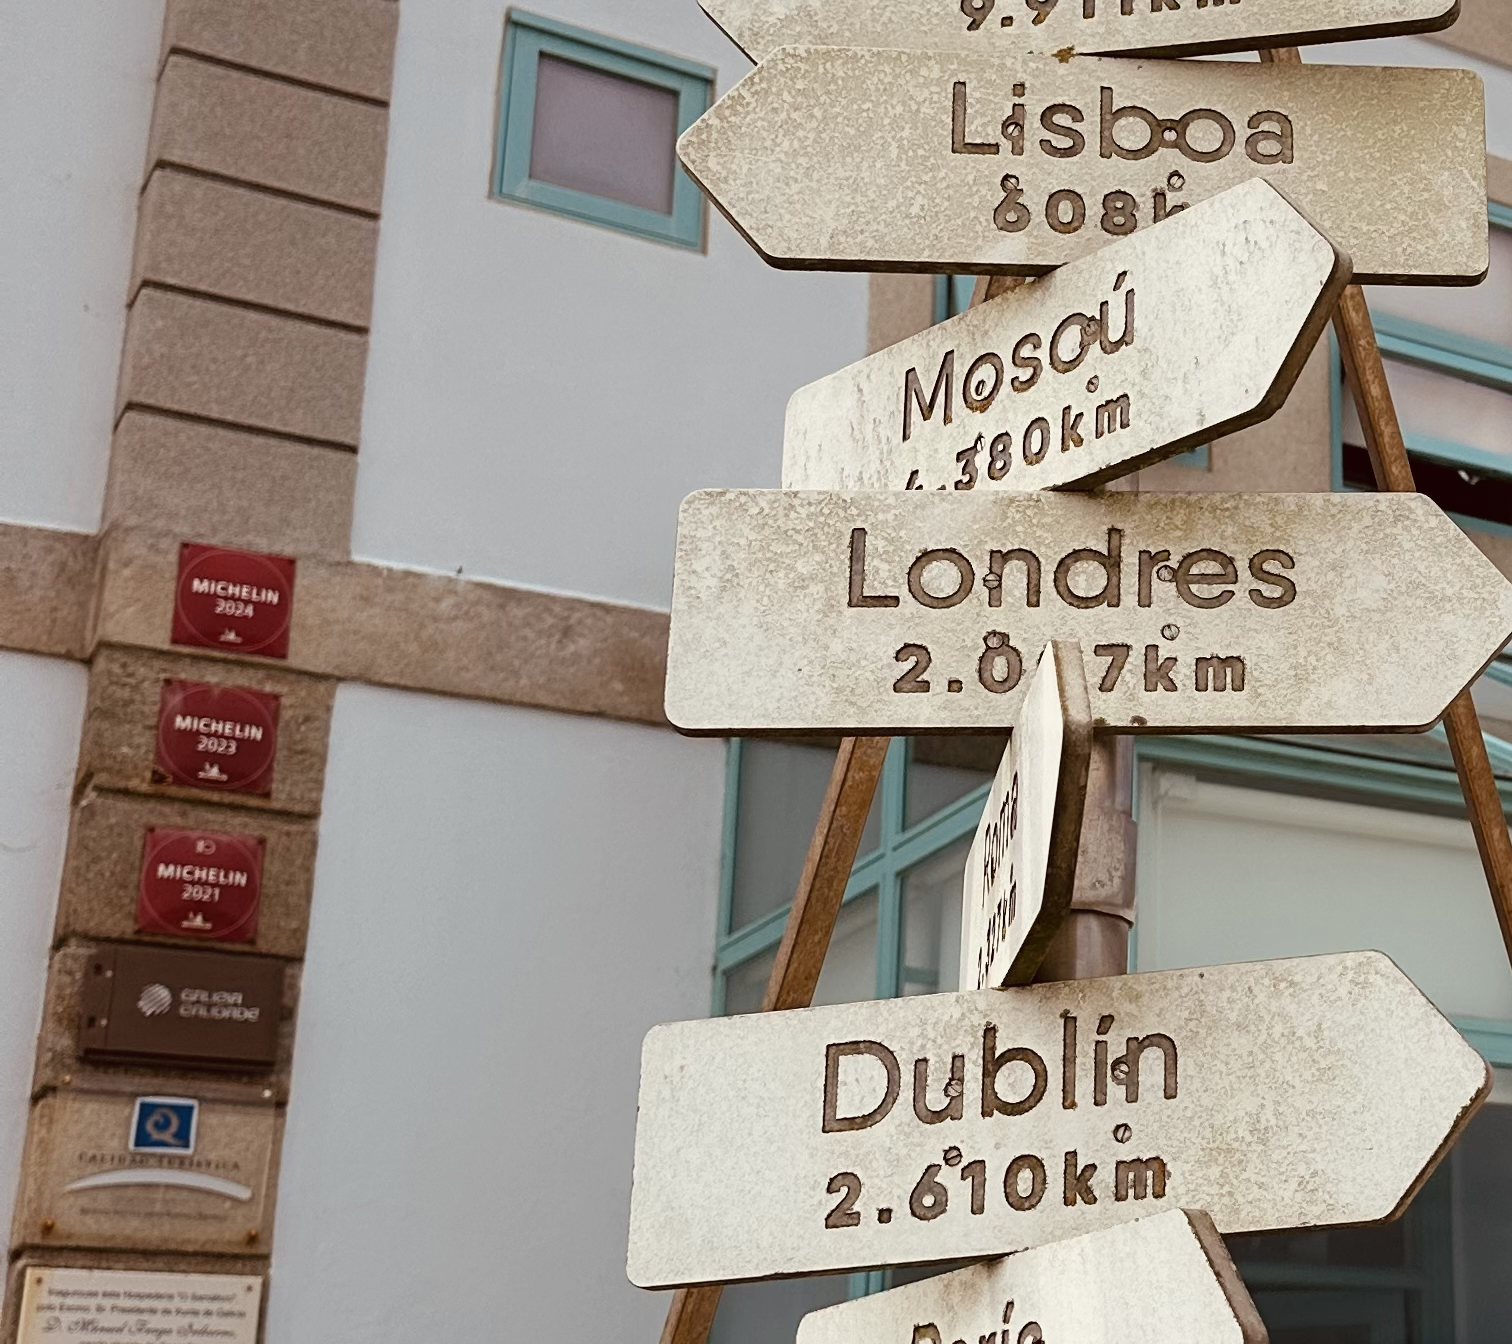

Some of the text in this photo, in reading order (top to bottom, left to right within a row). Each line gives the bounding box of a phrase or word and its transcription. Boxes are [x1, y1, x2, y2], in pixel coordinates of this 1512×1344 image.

[951, 81, 1295, 165] Lisboa
[901, 270, 1136, 442] Moscú
[191, 576, 280, 605] MICHELIN
[847, 527, 1298, 609] Londres
[214, 599, 254, 619] 2024
[892, 642, 1246, 694] 2.07km
[174, 713, 263, 742] MICHELIN
[156, 862, 247, 887] MICHELIN
[821, 1013, 1179, 1133] Dublín
[823, 1150, 1170, 1230] 2.610km
